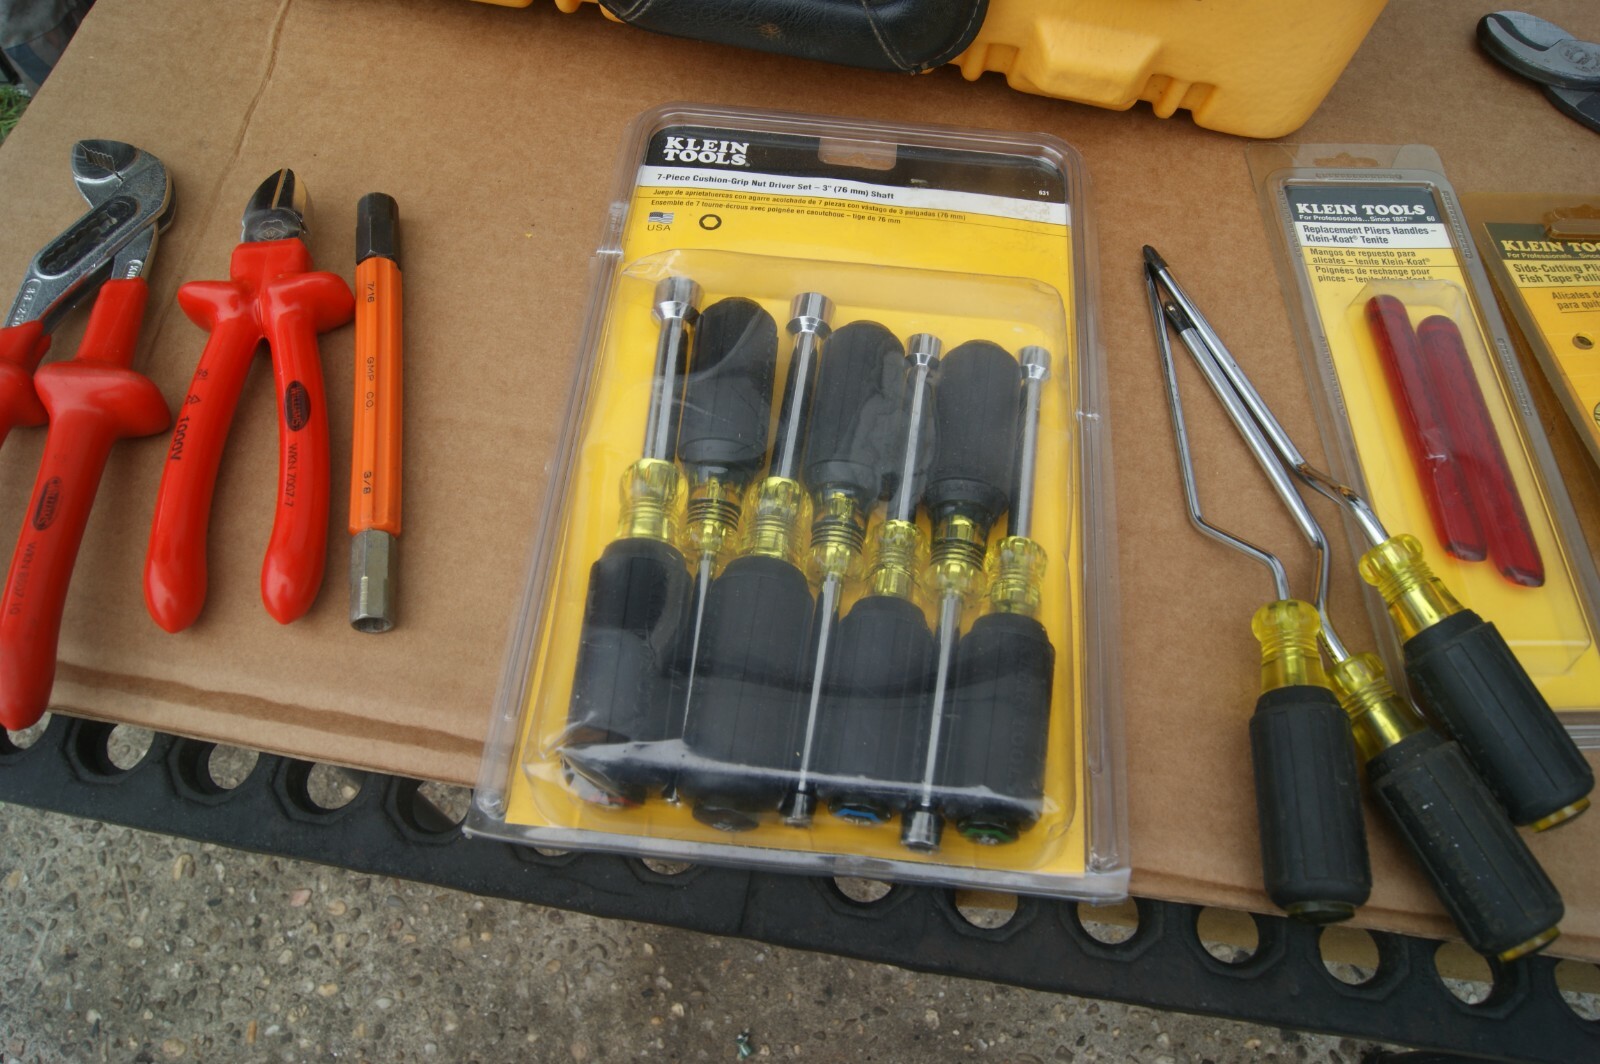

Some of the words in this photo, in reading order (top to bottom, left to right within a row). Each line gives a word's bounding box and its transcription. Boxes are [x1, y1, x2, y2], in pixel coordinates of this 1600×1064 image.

[665, 136, 750, 155] KLEIN
[663, 149, 747, 167] TOOLS
[657, 173, 691, 181] 7-Piece
[692, 174, 750, 187] Cushion-Grip
[769, 181, 795, 190] Driver
[850, 188, 869, 198] mm)
[870, 190, 894, 200] Shaft
[685, 190, 733, 199] aprietafuercas
[772, 196, 806, 204] acolchado
[904, 210, 936, 218] pulgadas
[702, 201, 749, 210] tourne-écrous
[767, 206, 794, 214] poignée
[806, 210, 845, 218] caoutchouc
[1296, 203, 1357, 215] KLEIN
[1362, 204, 1426, 216] TOOLS
[1302, 224, 1362, 235] Replacement
[1364, 226, 1391, 235] Pliers
[1392, 226, 1429, 235] Handles
[1360, 236, 1389, 244] Tenite
[1500, 240, 1565, 252] KLEIN
[1310, 248, 1344, 258] Mangos
[1358, 250, 1396, 258] repuesto
[1315, 266, 1355, 276] Poignées
[1369, 268, 1409, 277] rechange
[1514, 264, 1584, 274] Side-Cutting
[1318, 275, 1349, 283] pinces
[1518, 274, 1544, 283] Fish
[1545, 274, 1573, 284] Tape
[367, 280, 376, 302] 7/16
[1552, 292, 1590, 300] Alicates
[1556, 302, 1580, 310] para
[366, 356, 374, 382] GMP
[171, 416, 190, 460] 1000V
[288, 443, 298, 470] WKN
[362, 470, 372, 494] 3/8
